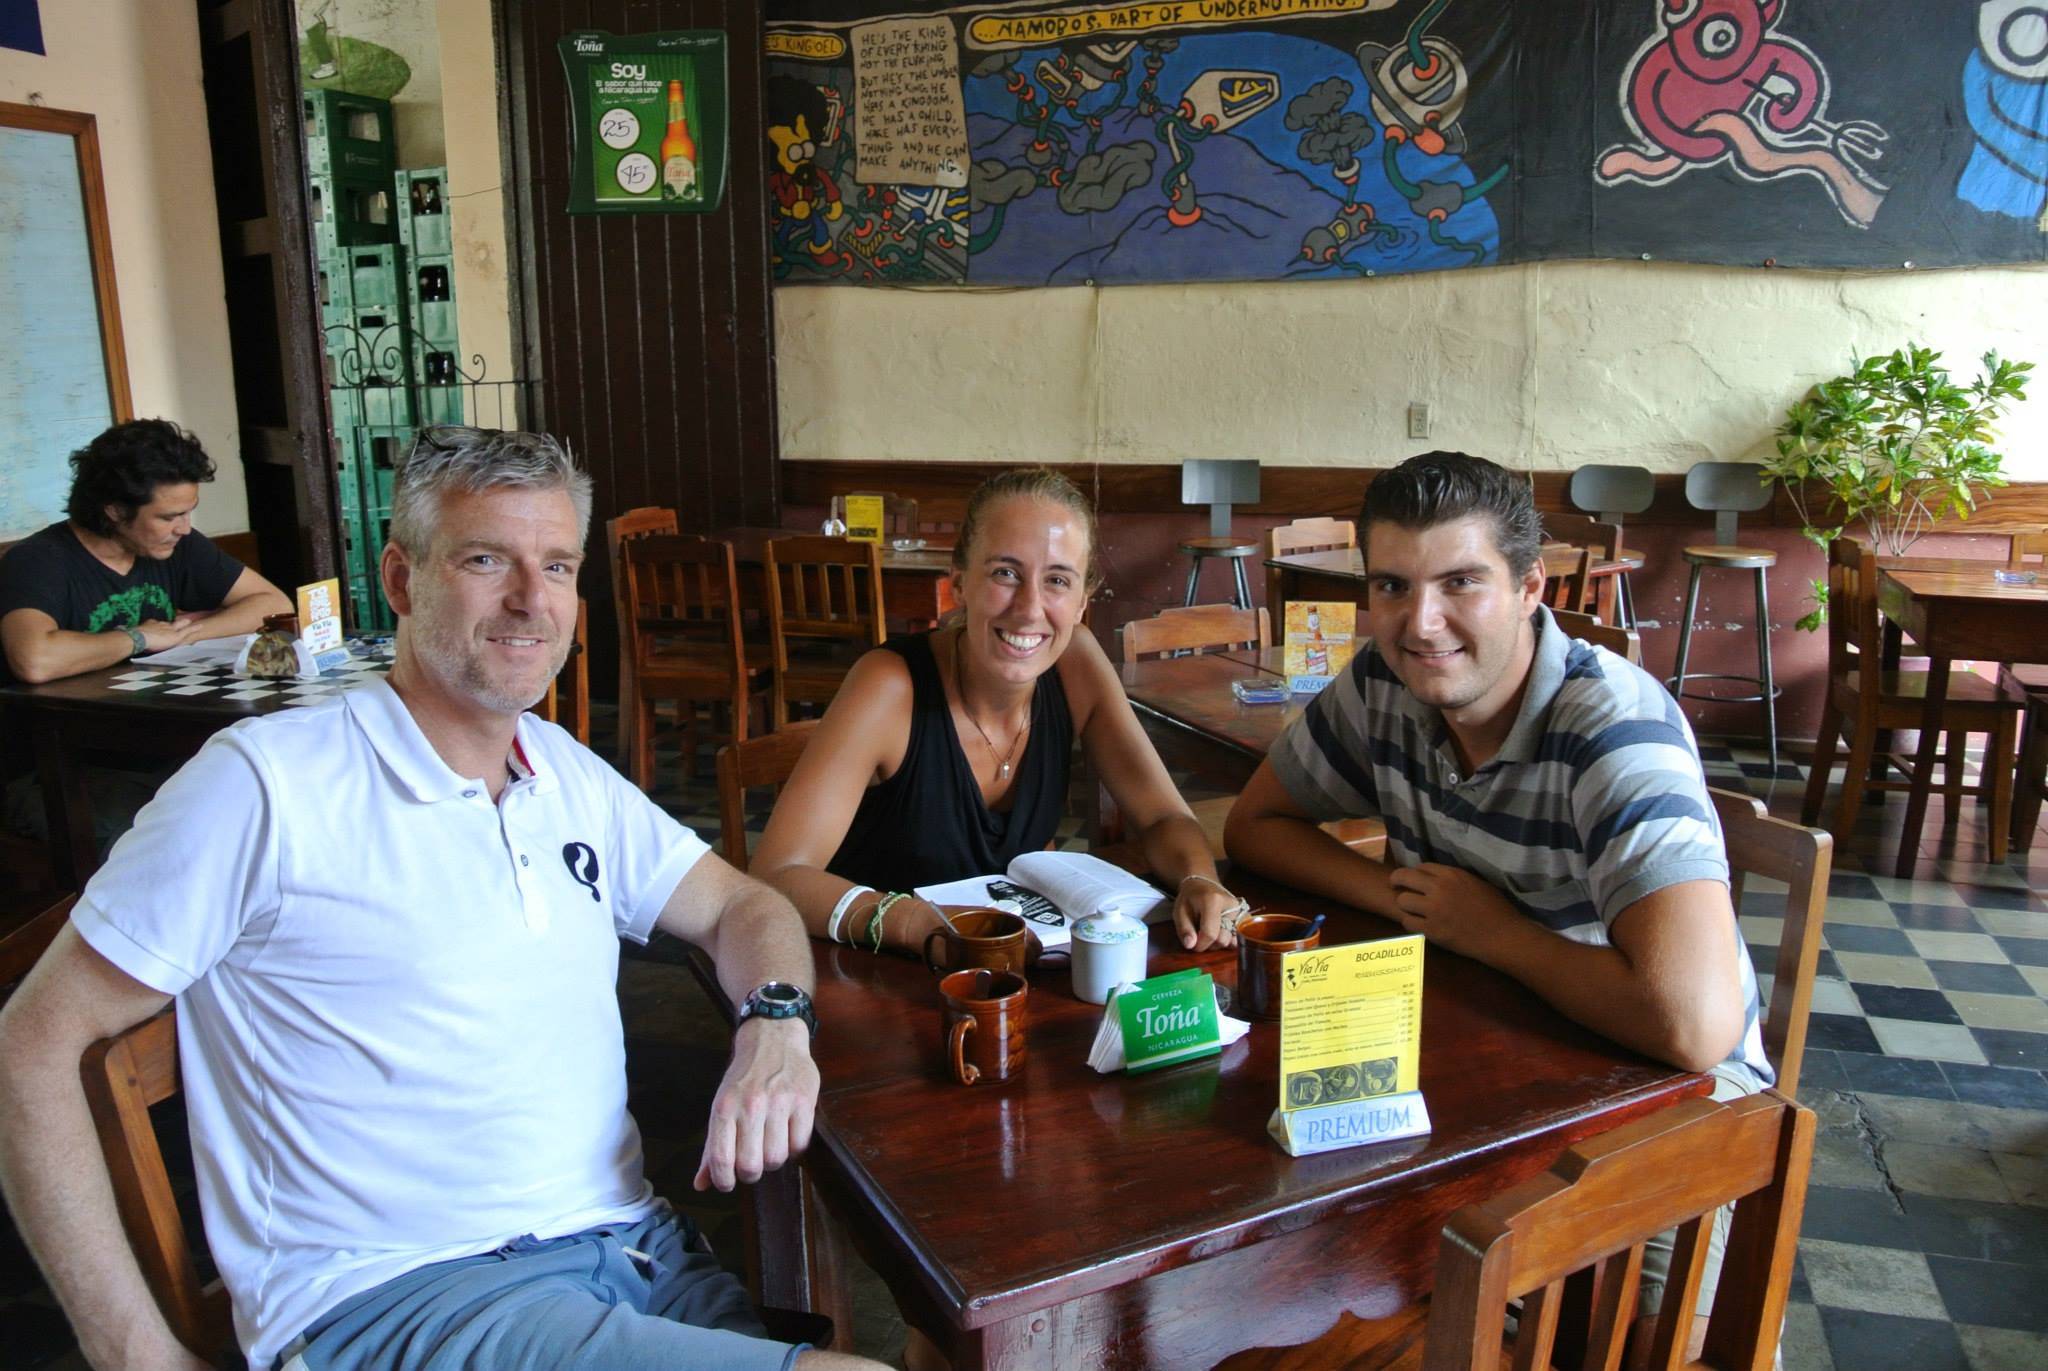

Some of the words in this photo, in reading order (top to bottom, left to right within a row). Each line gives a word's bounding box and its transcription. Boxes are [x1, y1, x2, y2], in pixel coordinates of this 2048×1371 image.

[1110, 10, 1153, 26] PART
[1159, 6, 1184, 22] OF
[573, 39, 604, 52] Toña
[861, 33, 886, 46] HE'S
[610, 62, 646, 81] Soy
[909, 70, 929, 81] THE
[930, 82, 947, 94] HE
[888, 100, 896, 109] A
[908, 111, 916, 120] A
[860, 141, 894, 155] THING
[903, 141, 924, 155] AND
[927, 143, 942, 156] HE
[1355, 946, 1414, 962] BOCADILLOS
[1151, 989, 1182, 1001] CERVEZA
[1136, 1004, 1200, 1038] Toña
[1147, 1034, 1198, 1051] NICARAGUA
[1307, 1104, 1412, 1144] PREMIUM
